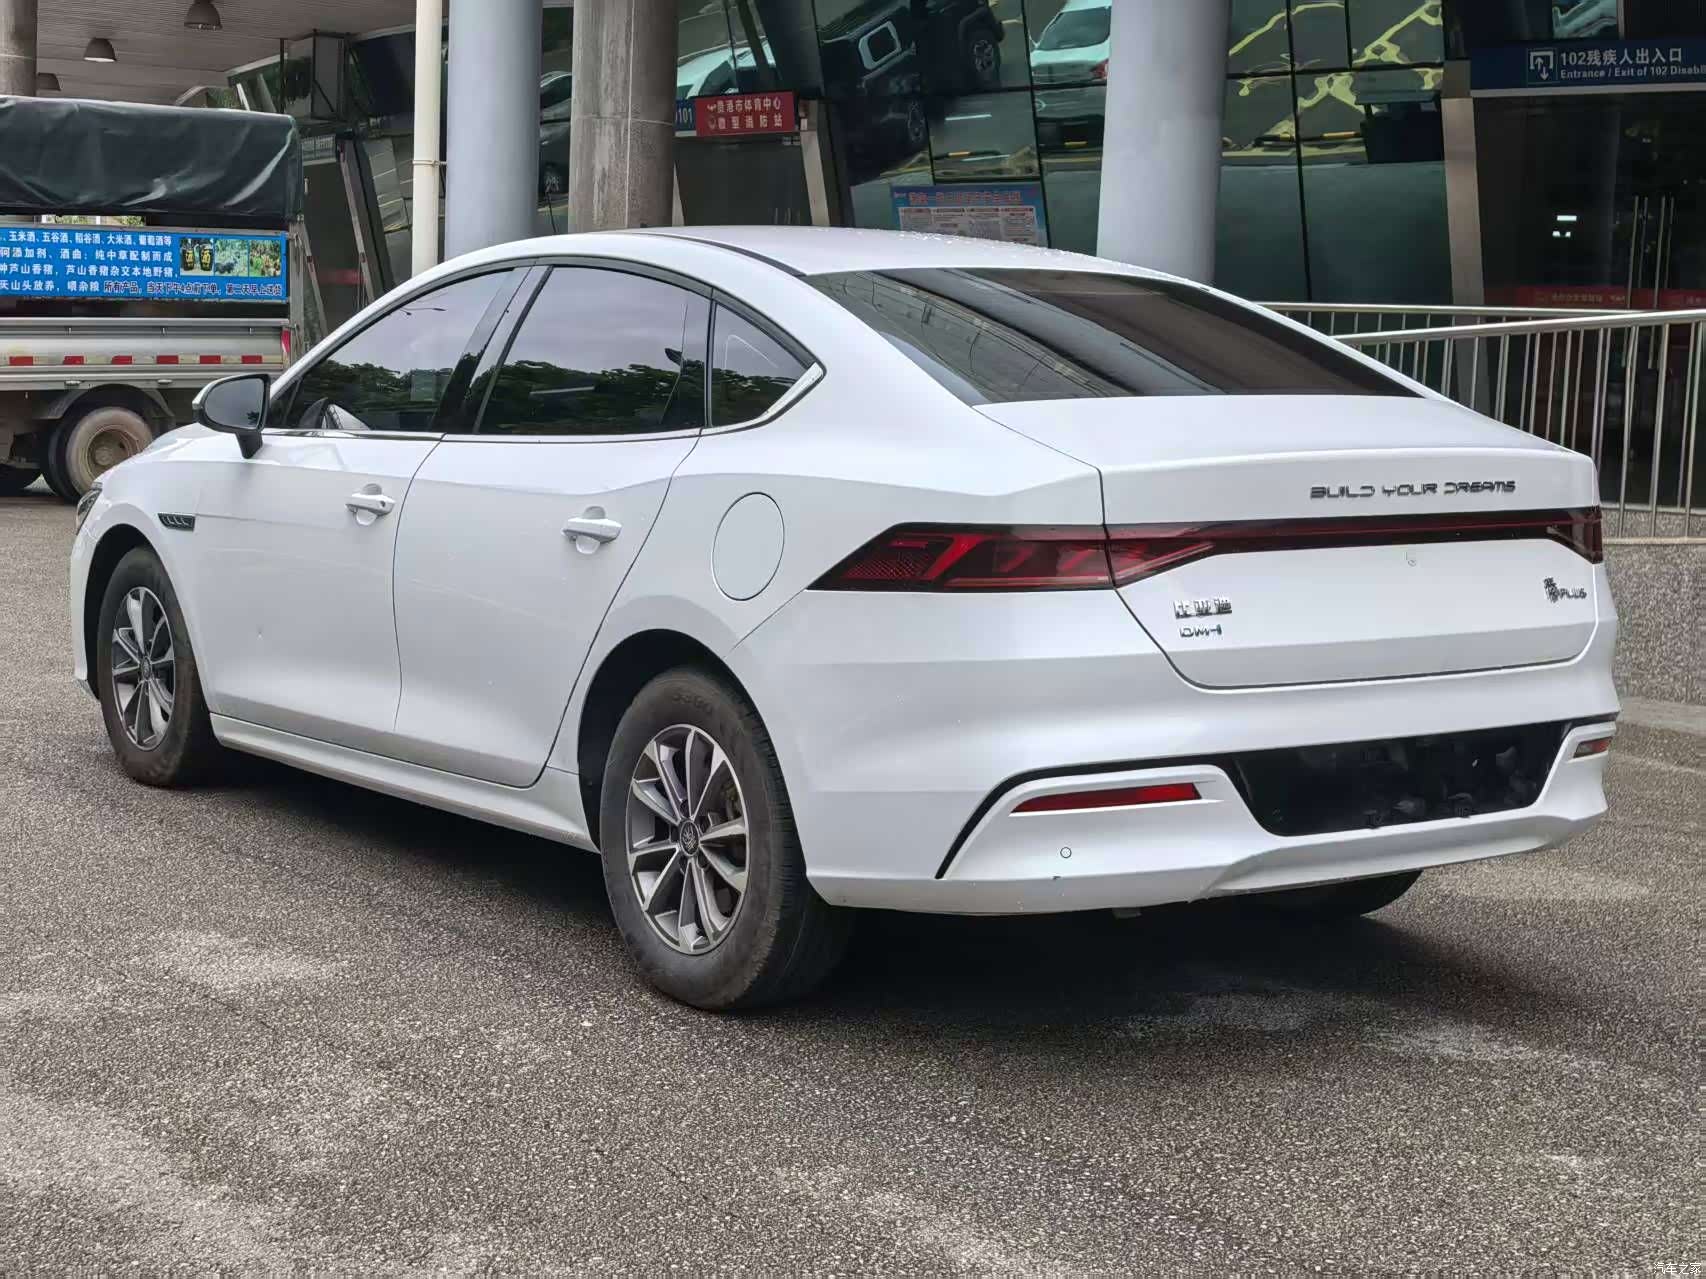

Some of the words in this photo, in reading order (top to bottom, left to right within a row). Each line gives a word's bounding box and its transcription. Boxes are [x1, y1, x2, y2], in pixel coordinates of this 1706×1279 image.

[1560, 48, 1682, 66] 102残疾人出入口
[1560, 69, 1606, 80] Entrance
[1614, 67, 1634, 77] Exit
[1638, 67, 1648, 77] of
[1651, 66, 1668, 76] 102
[1310, 485, 1375, 500] BUILD
[1382, 482, 1437, 497] YOUR
[1443, 480, 1516, 495] DREAMS
[1173, 598, 1232, 619] 比亚迪
